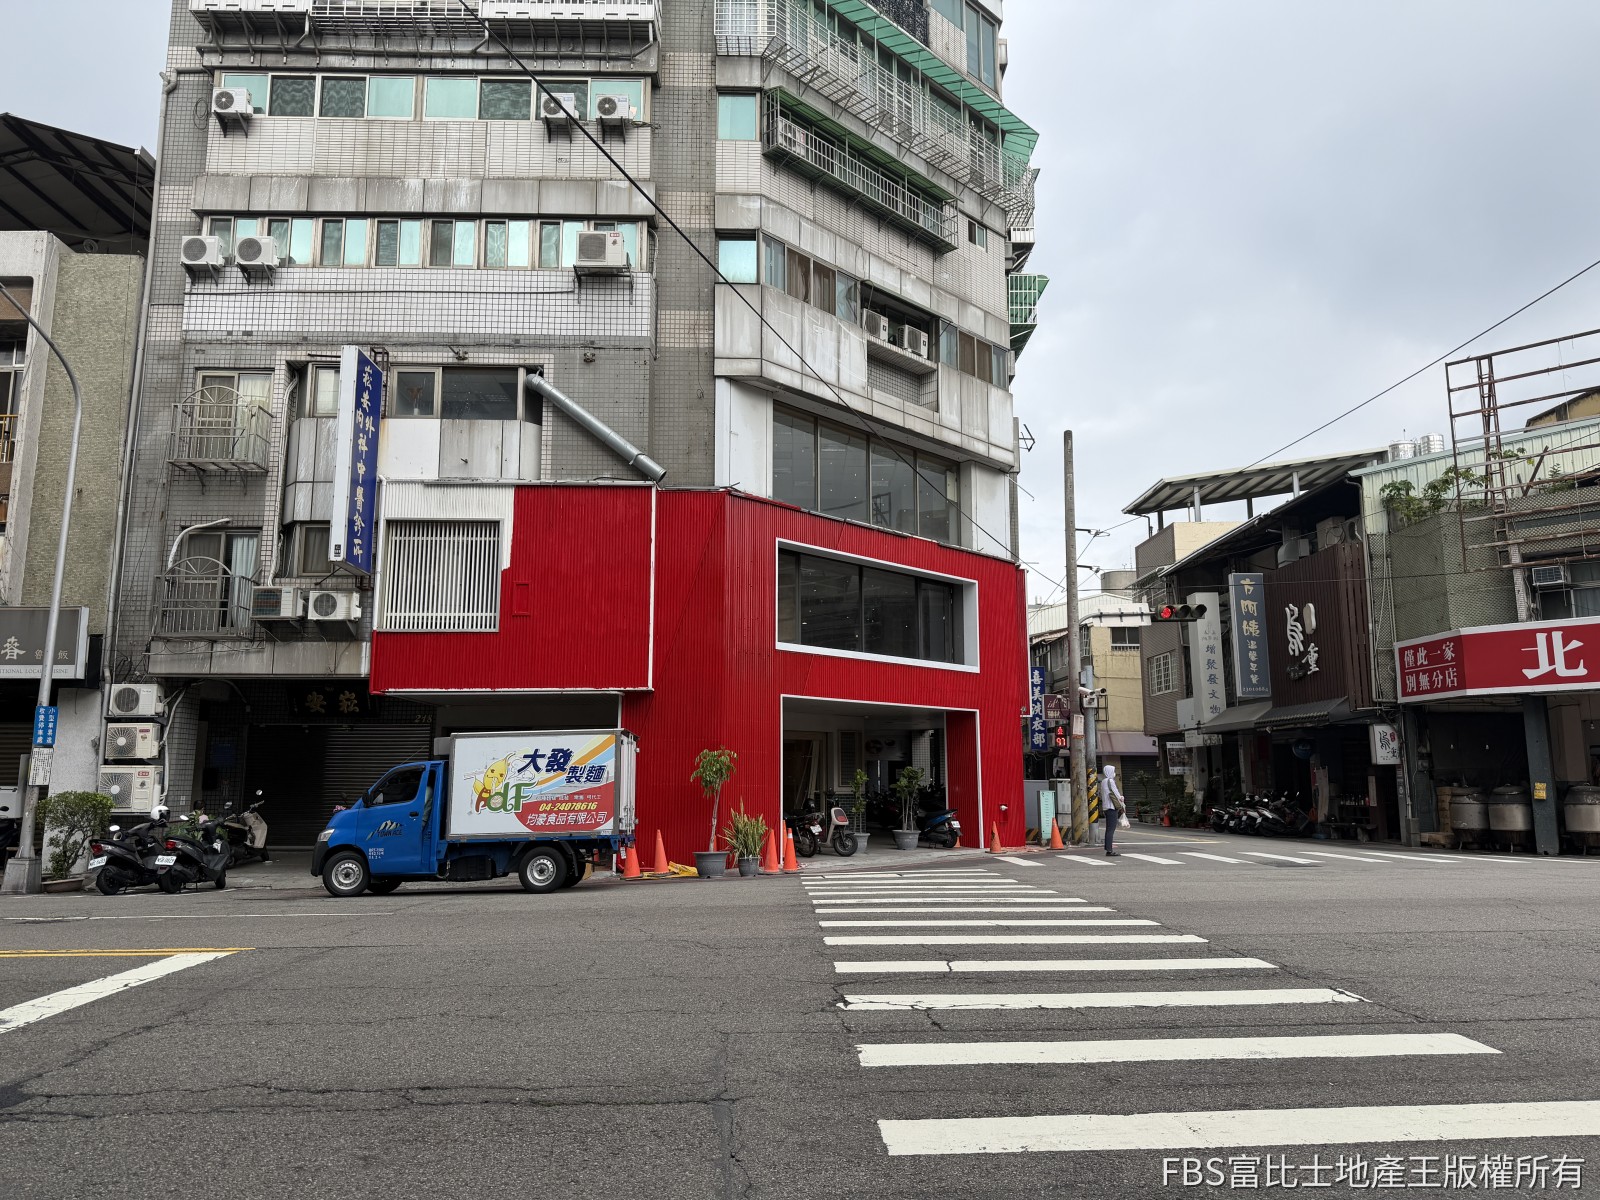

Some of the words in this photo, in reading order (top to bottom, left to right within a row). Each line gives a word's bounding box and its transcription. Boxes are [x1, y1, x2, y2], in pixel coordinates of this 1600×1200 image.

[1404, 641, 1456, 668] 僅此一家
[1521, 631, 1588, 679] 北
[1405, 667, 1457, 693] 別無分店
[1031, 669, 1046, 748] 喜美洗衣部
[517, 748, 573, 773] 大發
